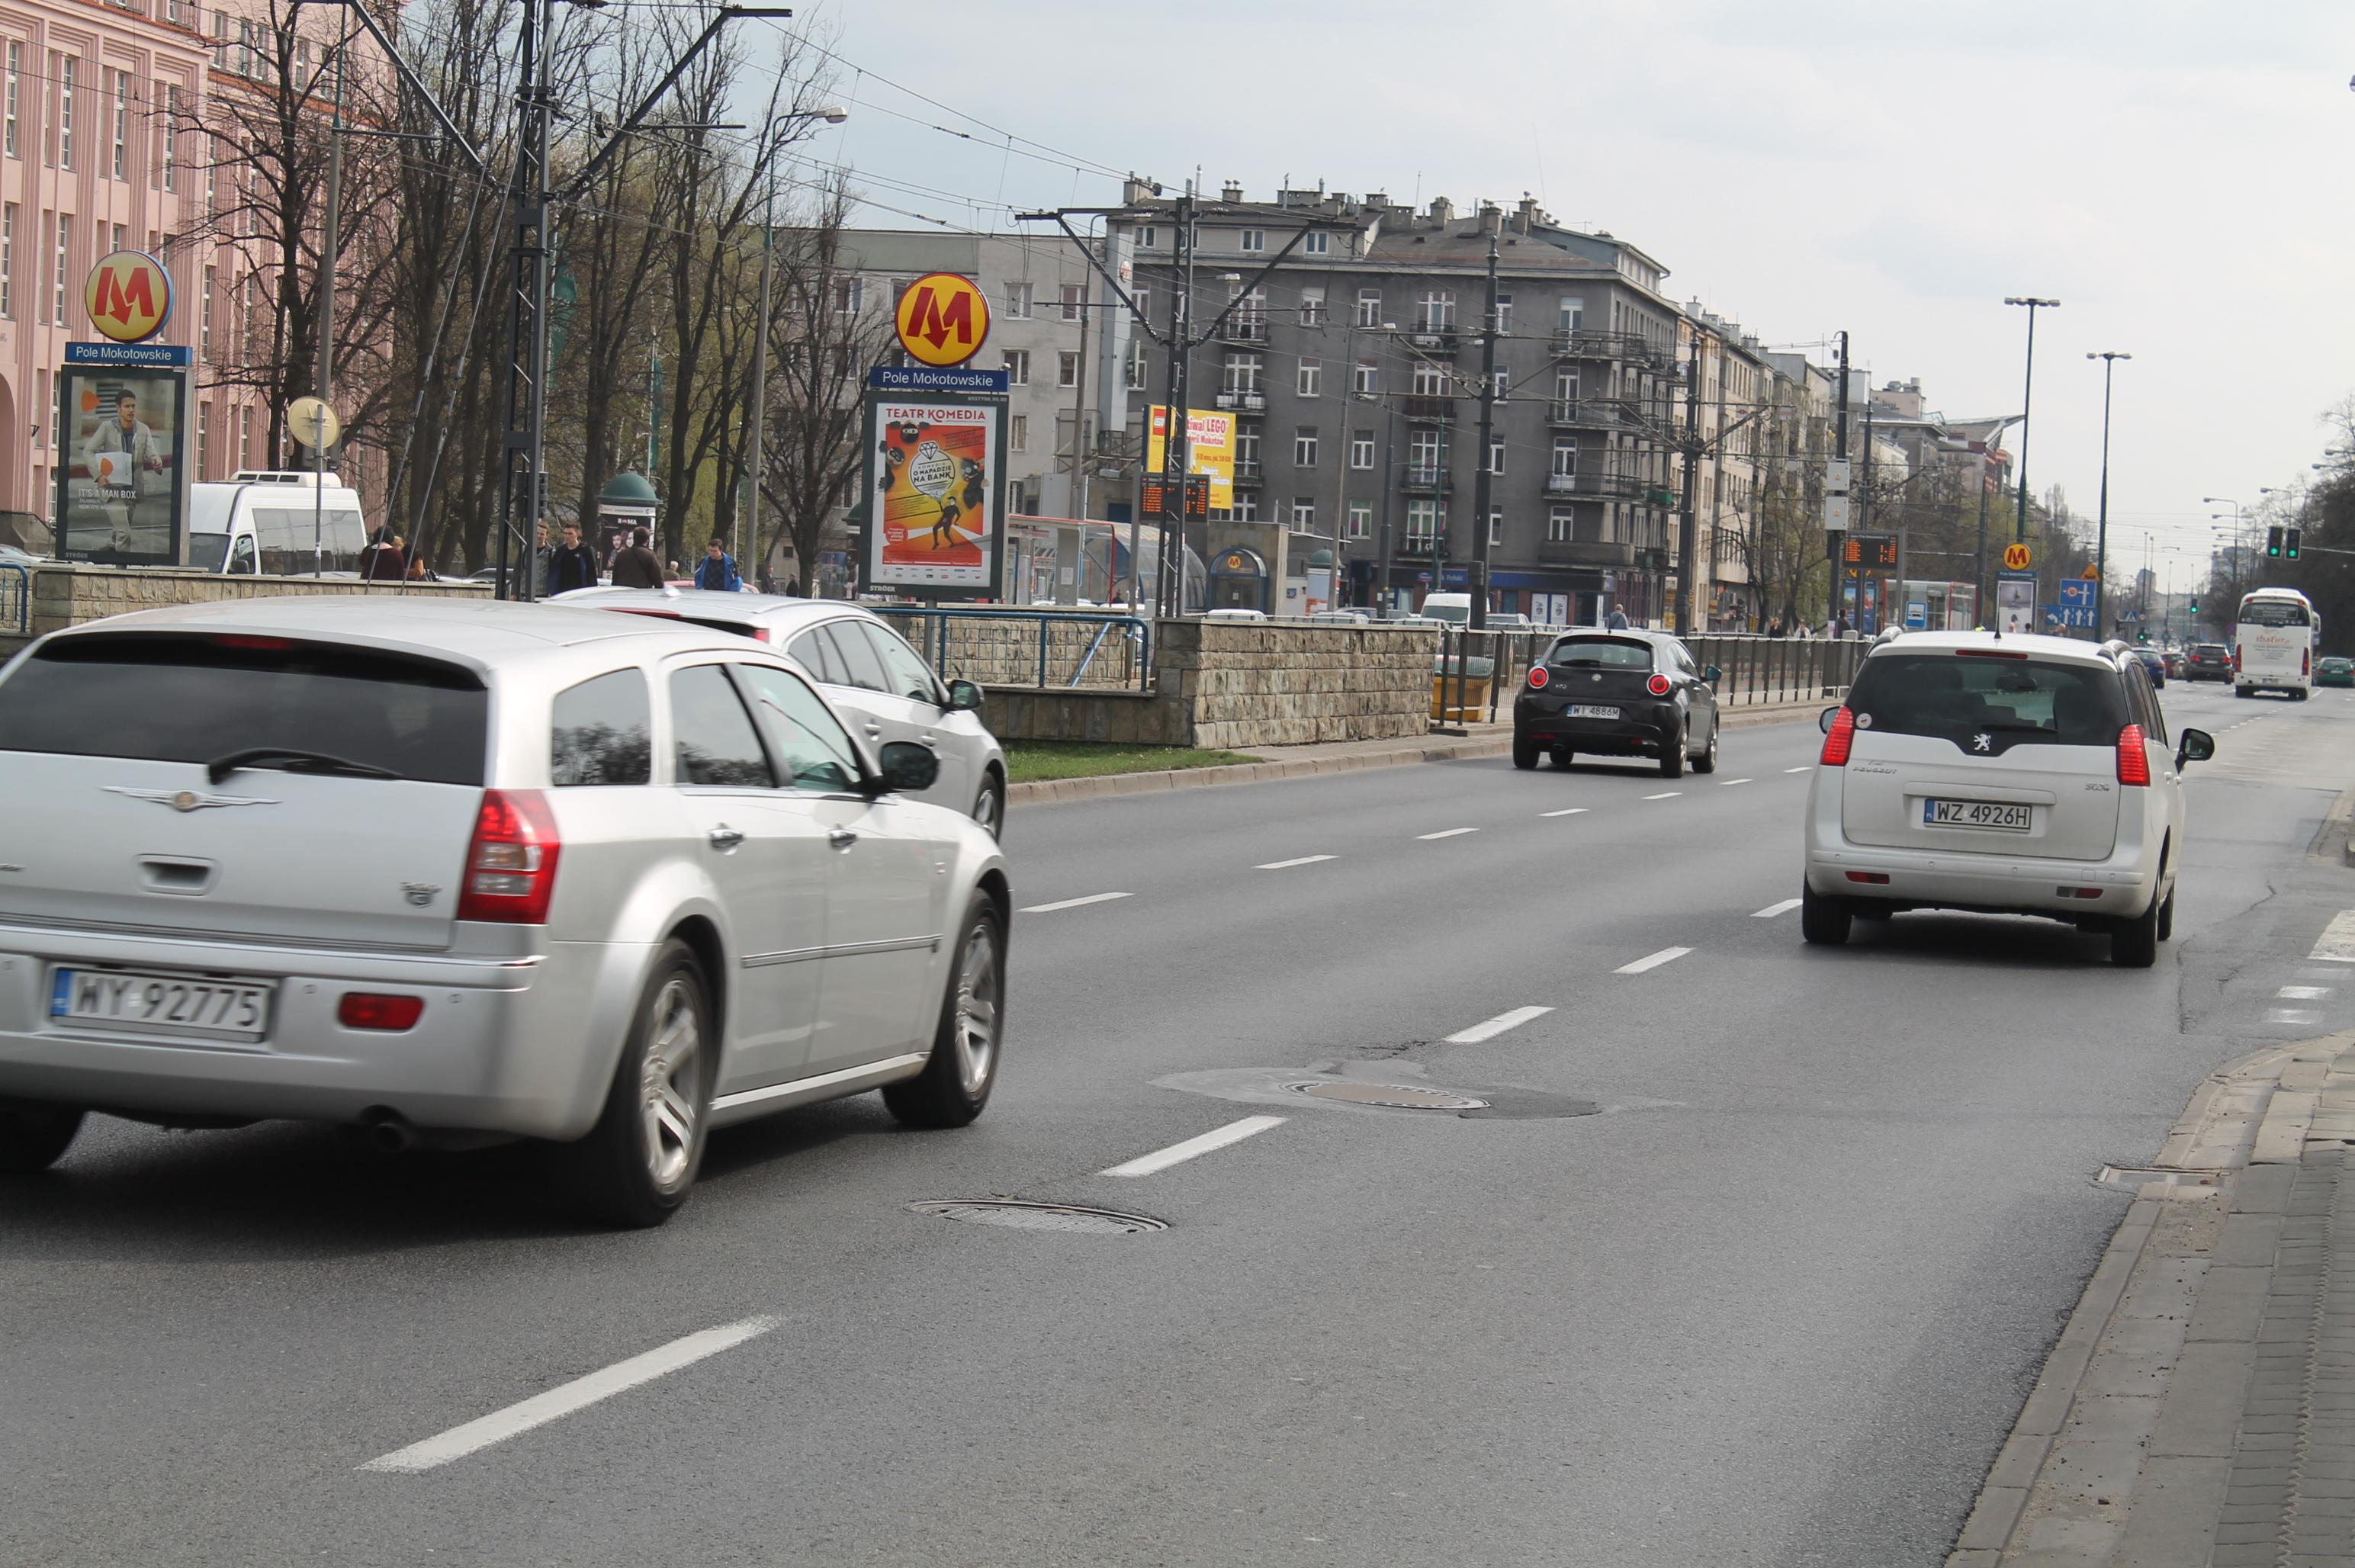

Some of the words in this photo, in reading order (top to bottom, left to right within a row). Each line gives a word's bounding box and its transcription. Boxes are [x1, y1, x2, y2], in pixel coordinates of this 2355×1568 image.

[76, 346, 98, 357] Pole
[101, 347, 172, 360] Mokotowskie
[883, 371, 909, 383] Pole
[914, 372, 994, 386] Mokotowskie
[886, 408, 924, 419] TEATR
[928, 409, 986, 423] KOMEDIA
[920, 465, 952, 475] NAPADZIE
[927, 471, 954, 480] BANK
[79, 488, 92, 497] IT'S
[95, 489, 100, 497] A
[101, 490, 119, 498] MAN
[120, 490, 137, 499] BOX
[1938, 803, 1964, 821] WZ
[1970, 805, 2028, 826] 4926H
[76, 976, 133, 1015] WY
[141, 982, 259, 1027] 92775
